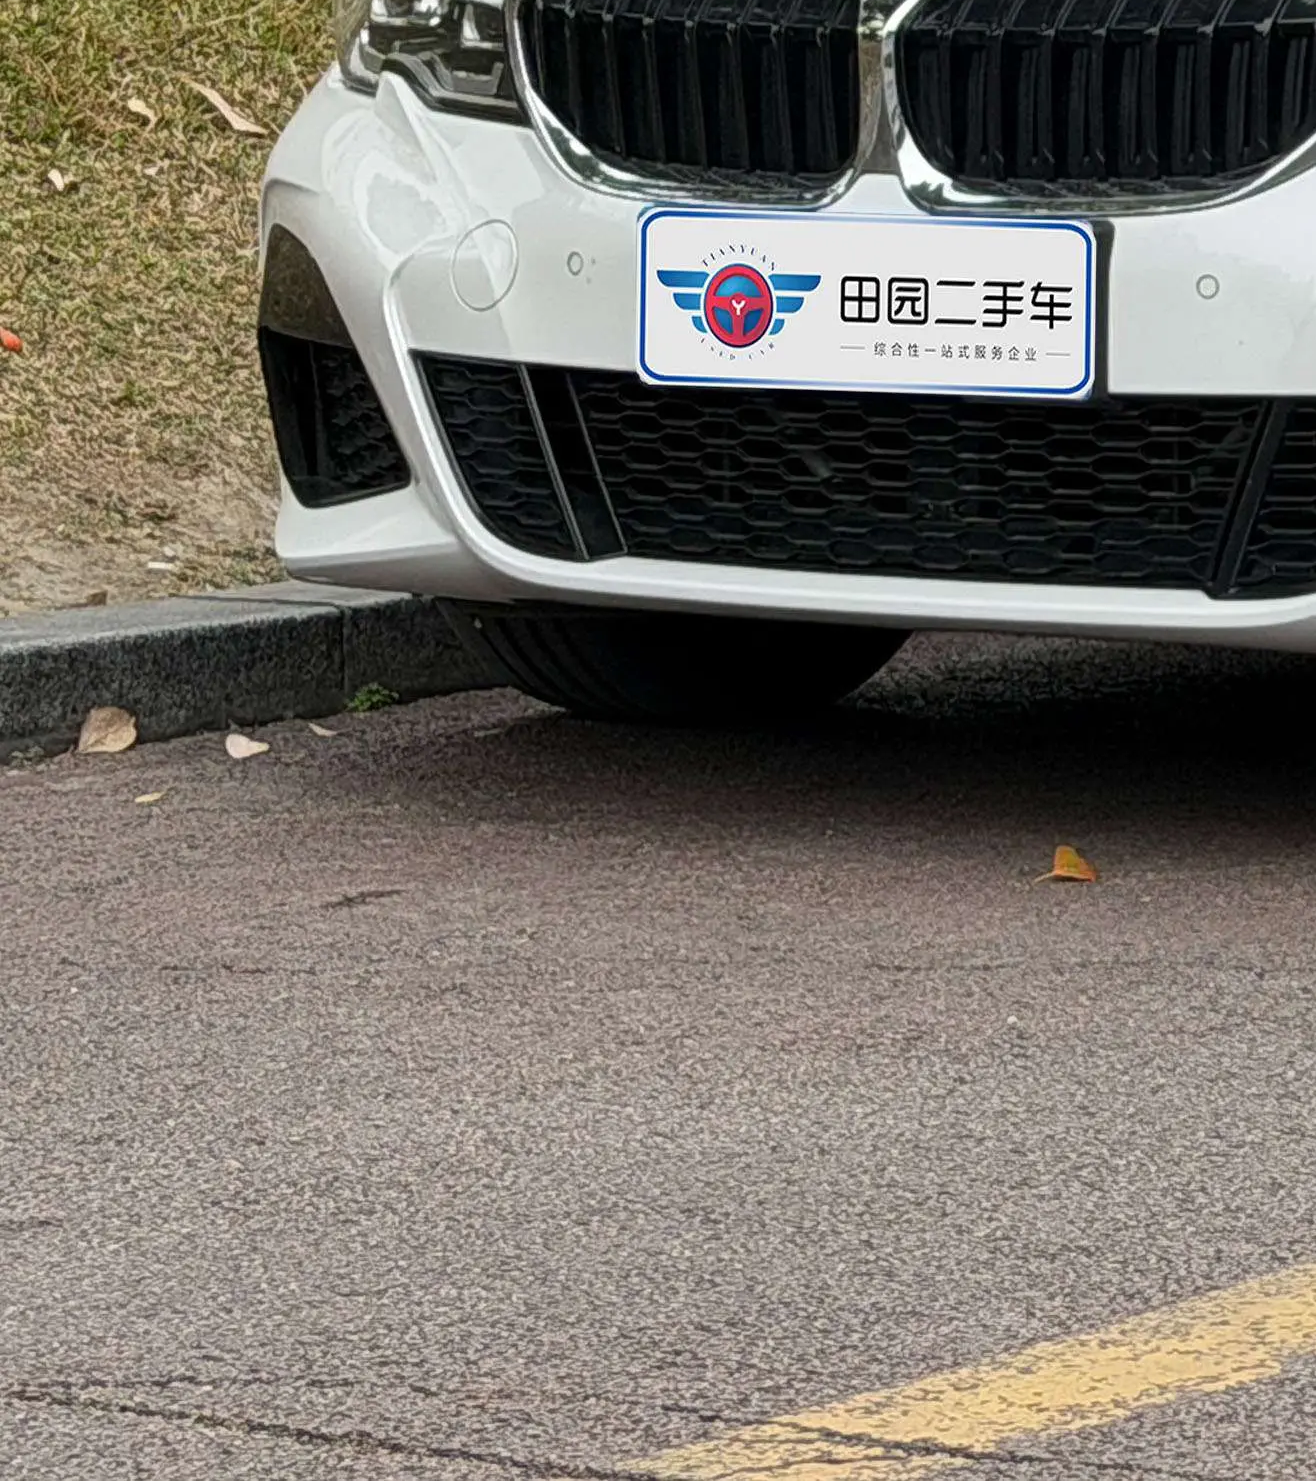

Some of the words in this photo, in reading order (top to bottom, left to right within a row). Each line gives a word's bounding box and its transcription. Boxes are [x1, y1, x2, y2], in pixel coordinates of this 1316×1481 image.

[841, 275, 1073, 329] 田园二手车
[874, 342, 1037, 362] 综合性一站式服务企业
